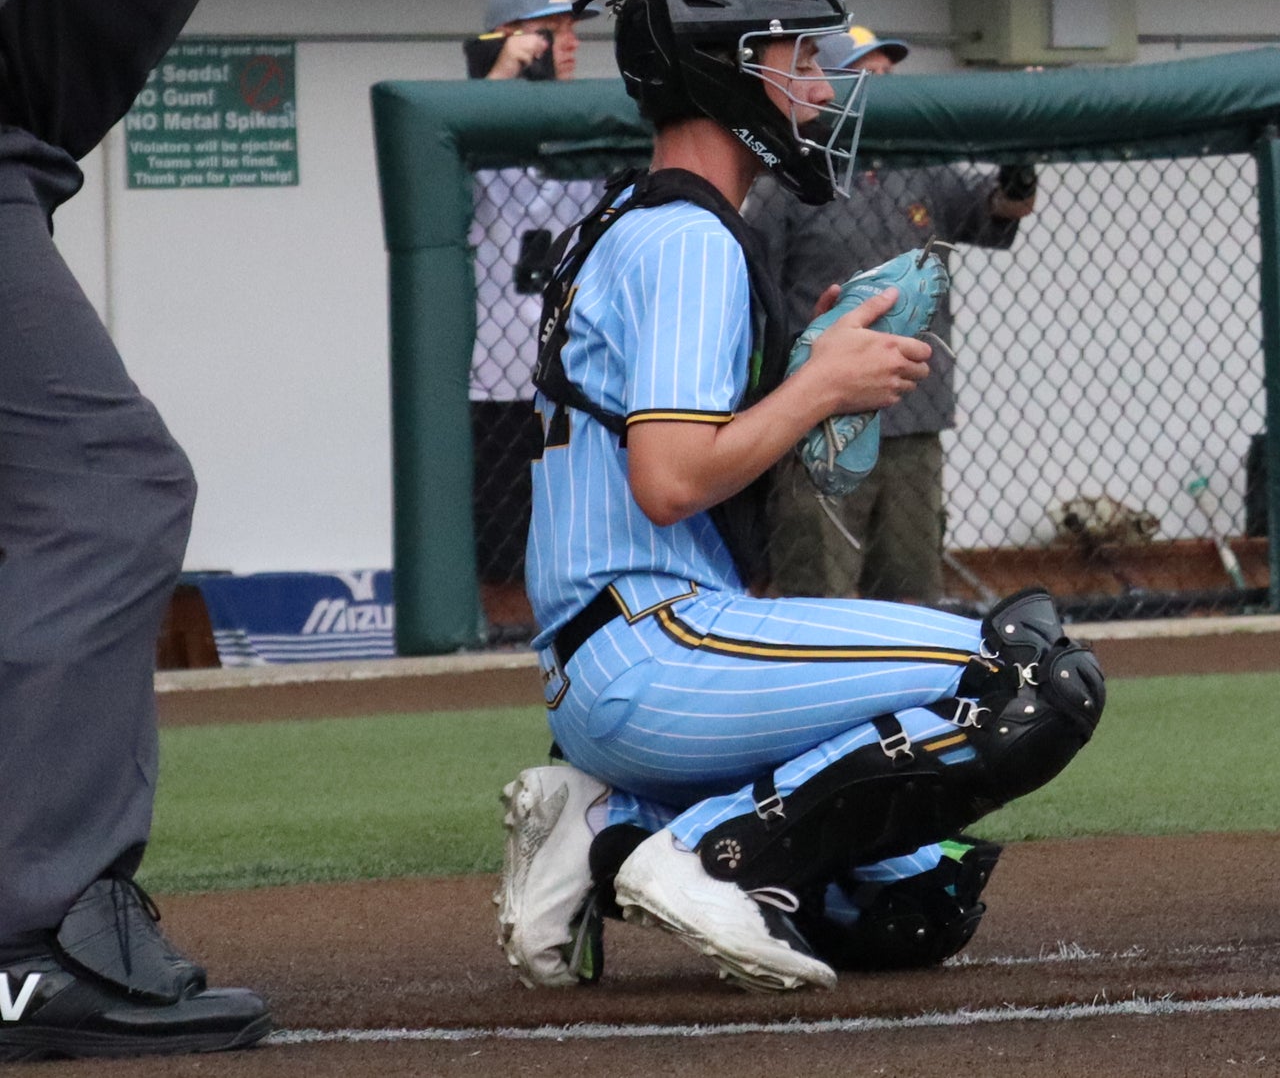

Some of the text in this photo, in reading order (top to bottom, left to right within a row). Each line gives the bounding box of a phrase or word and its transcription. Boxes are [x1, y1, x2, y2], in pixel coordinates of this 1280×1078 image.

[162, 64, 230, 83] Seeds!
[162, 88, 216, 106] Gum!
[126, 111, 296, 133] NO Metal Spikes!
[195, 141, 218, 152] will
[221, 140, 238, 152] be
[195, 155, 218, 168] will
[222, 155, 239, 167] be
[134, 171, 292, 187] Thank you for your help!
